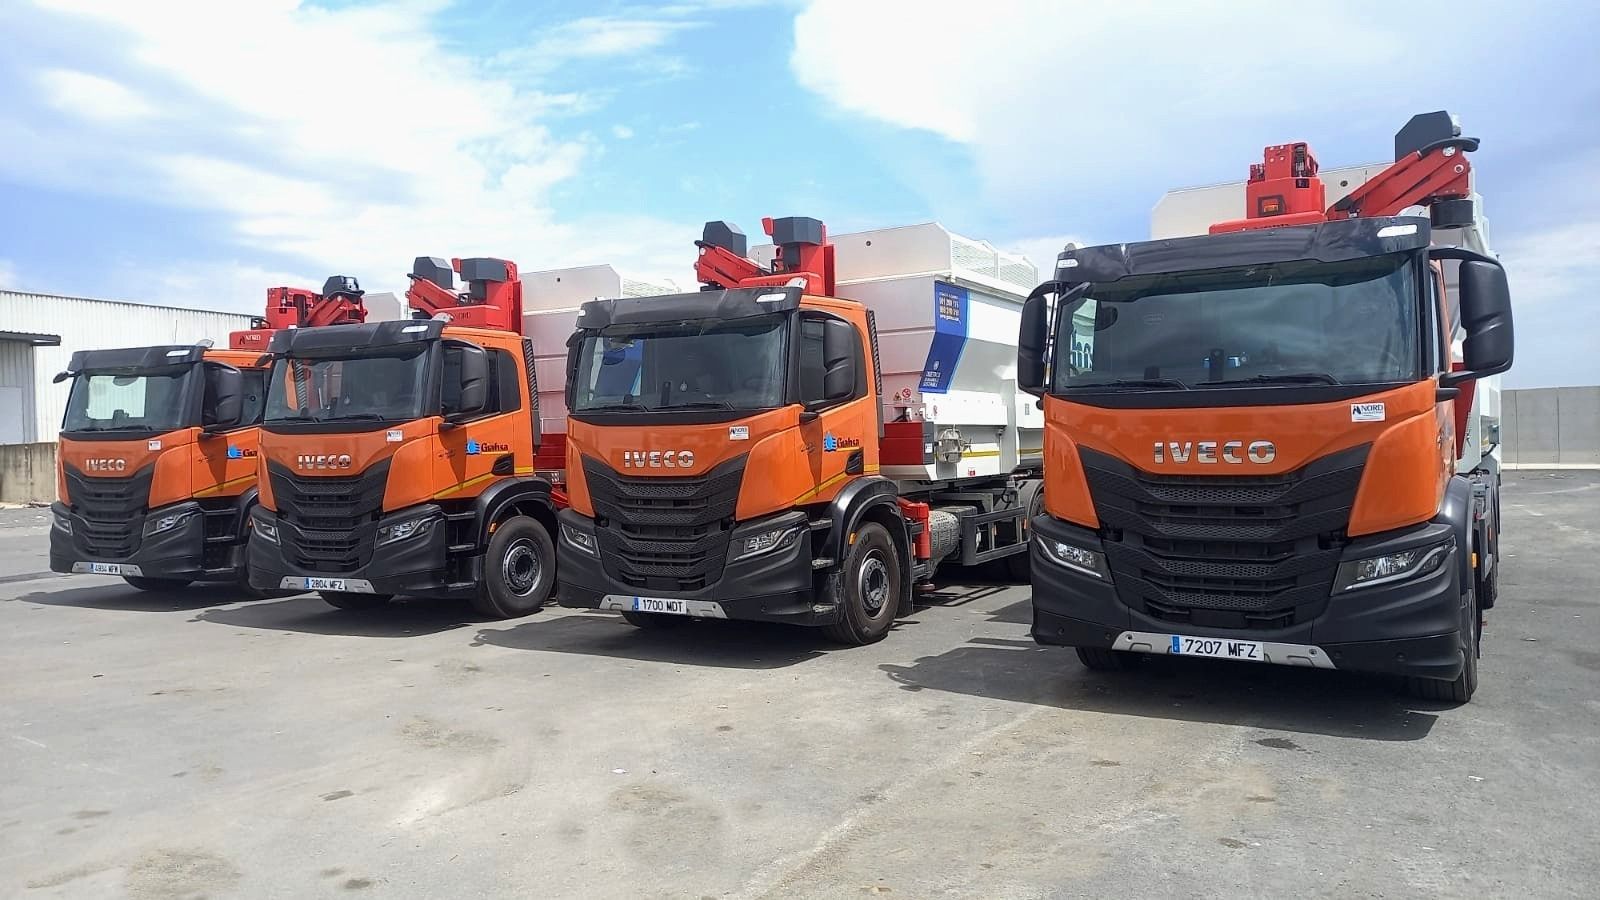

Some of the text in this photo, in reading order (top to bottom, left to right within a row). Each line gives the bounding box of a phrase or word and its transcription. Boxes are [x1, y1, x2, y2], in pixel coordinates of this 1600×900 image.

[481, 442, 508, 452] Giahsa
[1154, 440, 1276, 464] IVECO
[85, 459, 126, 471] IVECO
[298, 454, 351, 470] IVECO
[624, 450, 694, 468] IVECO
[311, 579, 343, 590] 2804 MFZ
[643, 599, 683, 613] 1700 MDT
[1185, 639, 1257, 659] 7207 MFZ
